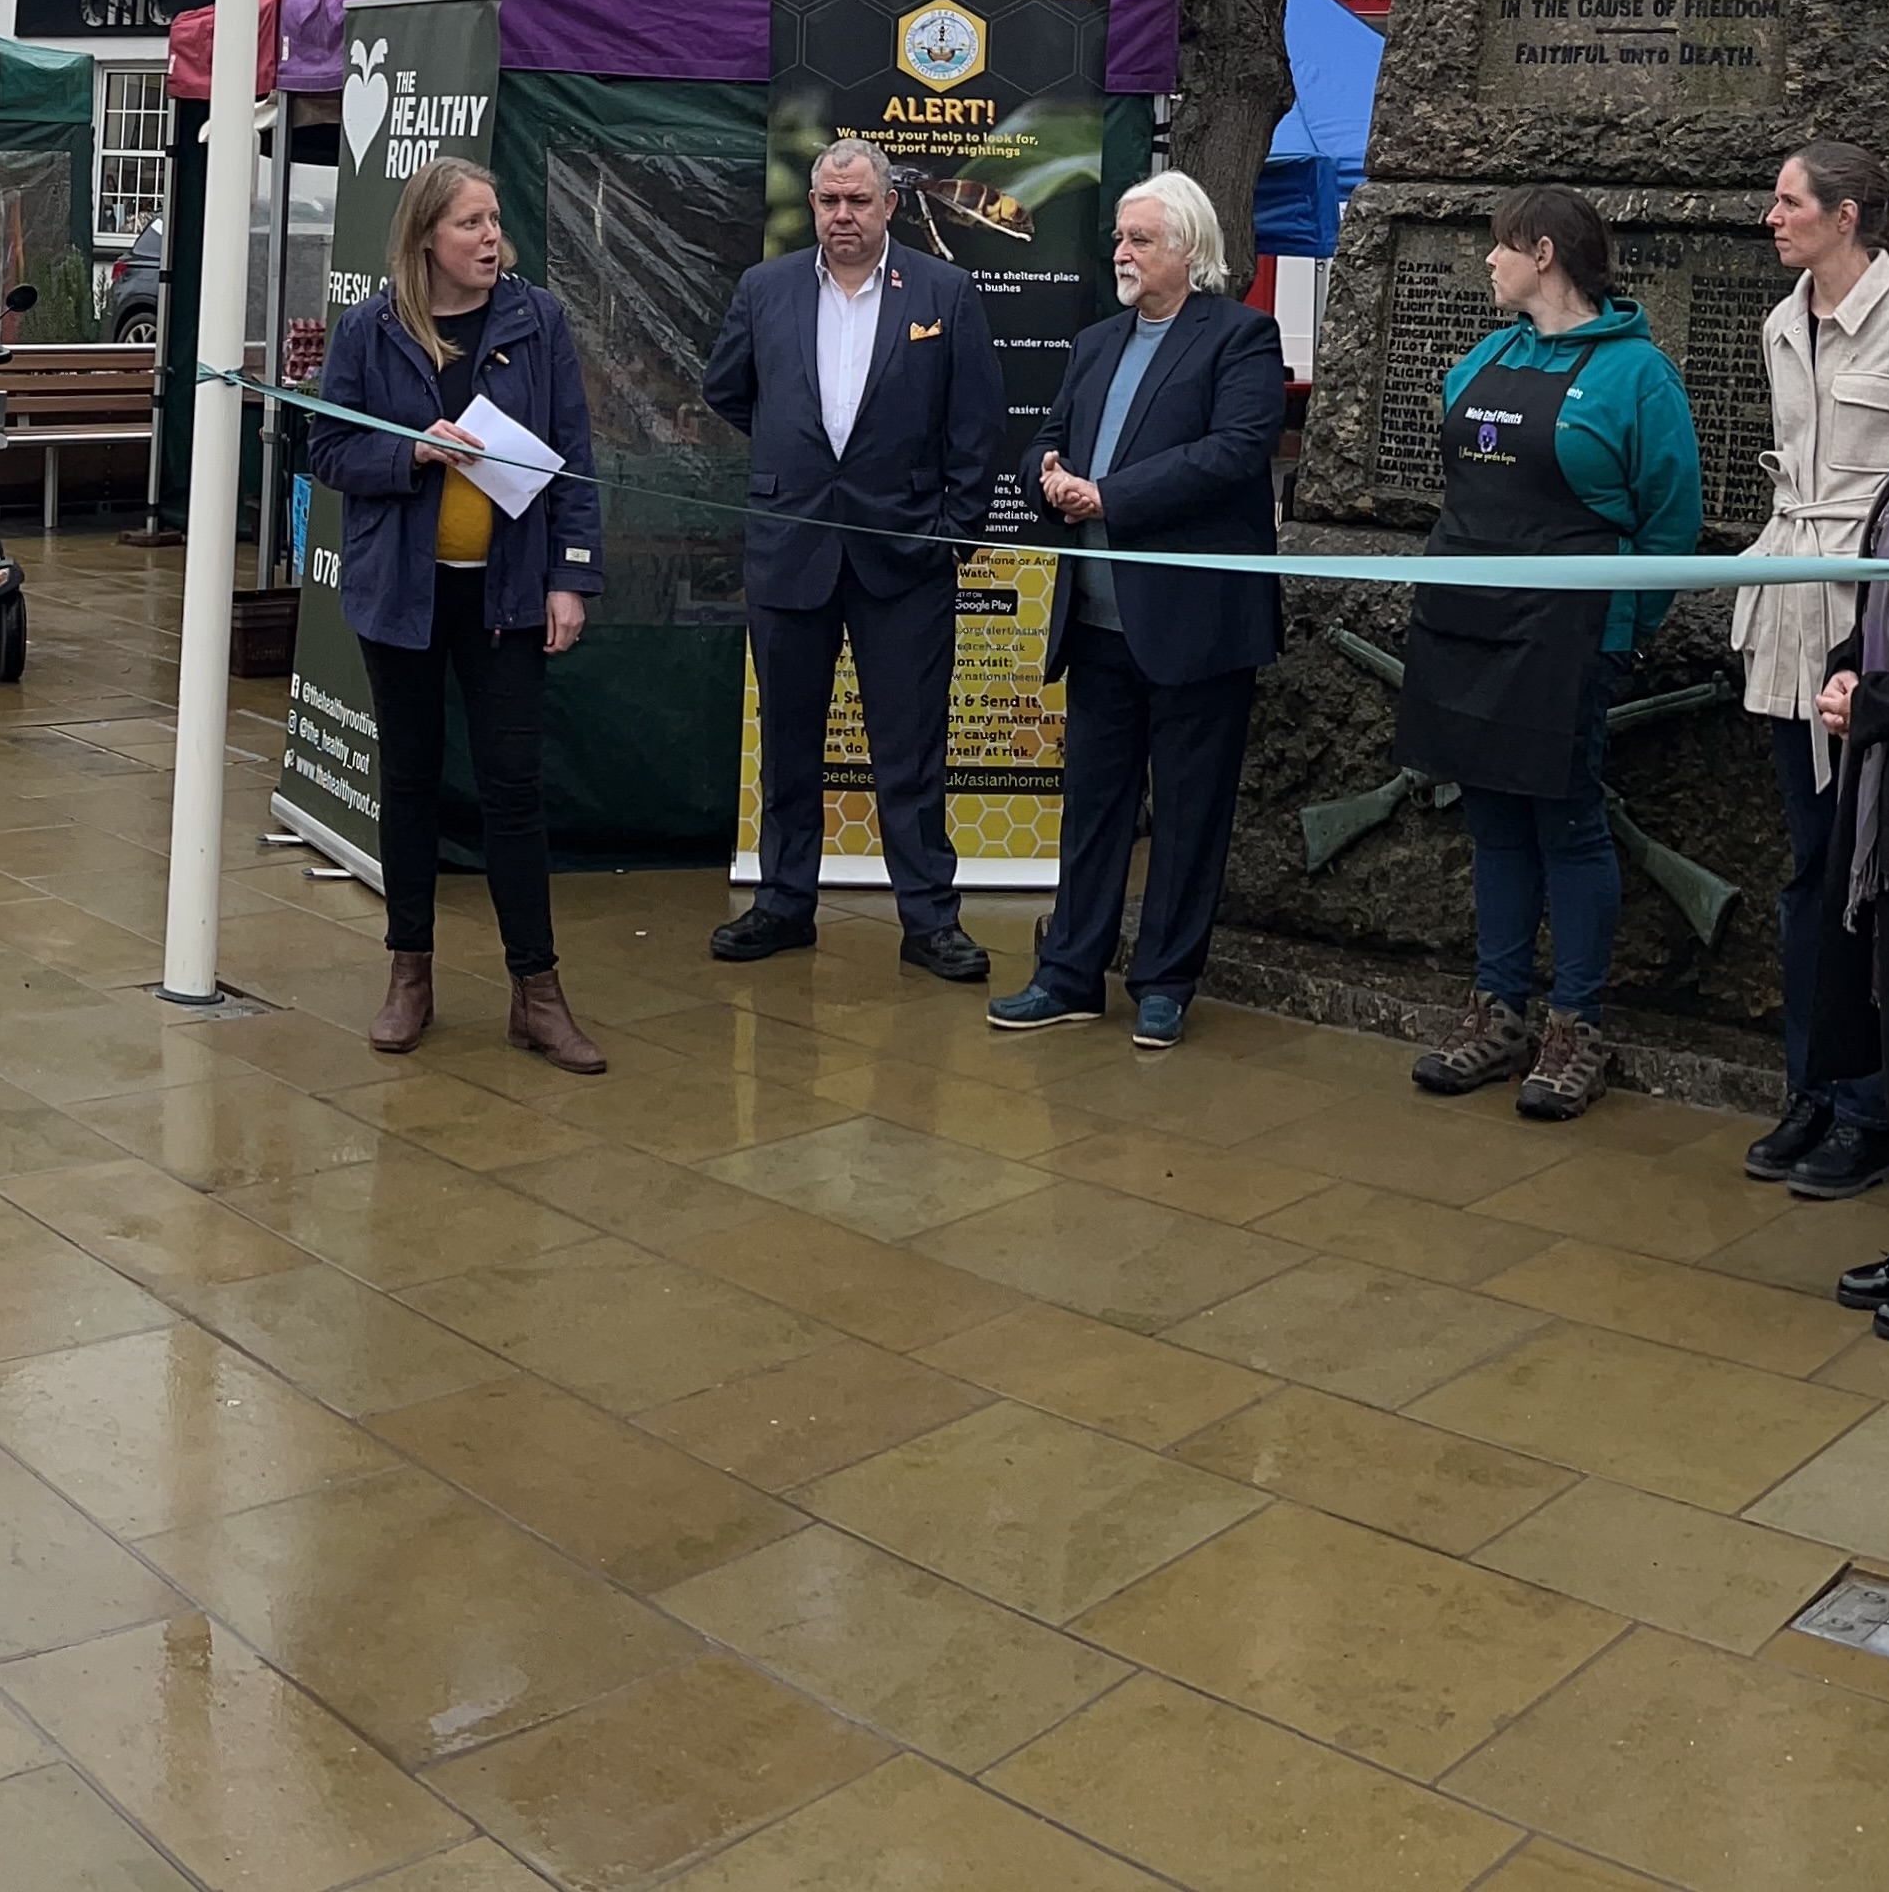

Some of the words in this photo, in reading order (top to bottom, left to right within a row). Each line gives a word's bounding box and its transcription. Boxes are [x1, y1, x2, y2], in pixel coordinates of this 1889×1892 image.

[1500, 0, 1520, 19] IN
[1515, 43, 1609, 65] FAITHFUL
[396, 71, 417, 94] THE
[390, 95, 488, 137] HEALTHY
[882, 96, 996, 125] ALERT!
[836, 128, 857, 140] We
[861, 129, 894, 141] need
[897, 131, 929, 144] your
[932, 131, 962, 145] help
[966, 132, 979, 143] to
[983, 132, 1012, 144] look
[1015, 133, 1039, 146] for,
[884, 142, 926, 156] report
[930, 144, 953, 157] any
[957, 144, 1020, 158] sightings
[385, 139, 440, 180] ROOT
[982, 271, 992, 280] in
[1003, 271, 1051, 281] sheltered
[1054, 272, 1080, 283] place
[1395, 275, 1439, 287] MAJOR
[327, 270, 371, 305] FRESH
[985, 284, 1021, 293] bushes
[1392, 300, 1434, 314] FLIGHT
[1690, 302, 1731, 316] ROYAL
[1391, 313, 1450, 328] SERGEANT
[1452, 314, 1475, 329] AIR
[1689, 316, 1732, 330] ROYAL
[1736, 317, 1761, 331] AIR
[1390, 327, 1451, 341] SERGEANT
[1688, 329, 1731, 344] ROYAL
[1734, 331, 1761, 345] AIR
[1011, 339, 1042, 348] under
[1388, 339, 1428, 354] PILOT
[1687, 344, 1730, 358] ROYAL
[1733, 346, 1760, 360] AIR
[1387, 352, 1454, 368] CORPORAL
[1686, 358, 1730, 372] ROYAL
[1732, 360, 1759, 374] AIR
[1385, 365, 1434, 379] FLIGHT
[1383, 392, 1430, 407] DRIVER
[1008, 405, 1039, 415] easier
[1382, 406, 1435, 421] PRIVATE
[1379, 433, 1428, 448] STOKER
[1376, 458, 1430, 474] LEADING
[1375, 471, 1399, 486] BOY
[312, 547, 341, 590] 078
[991, 599, 1012, 612] Play
[980, 694, 1021, 708] Send
[969, 715, 991, 726] any
[998, 713, 1055, 725] material
[985, 746, 998, 757] at
